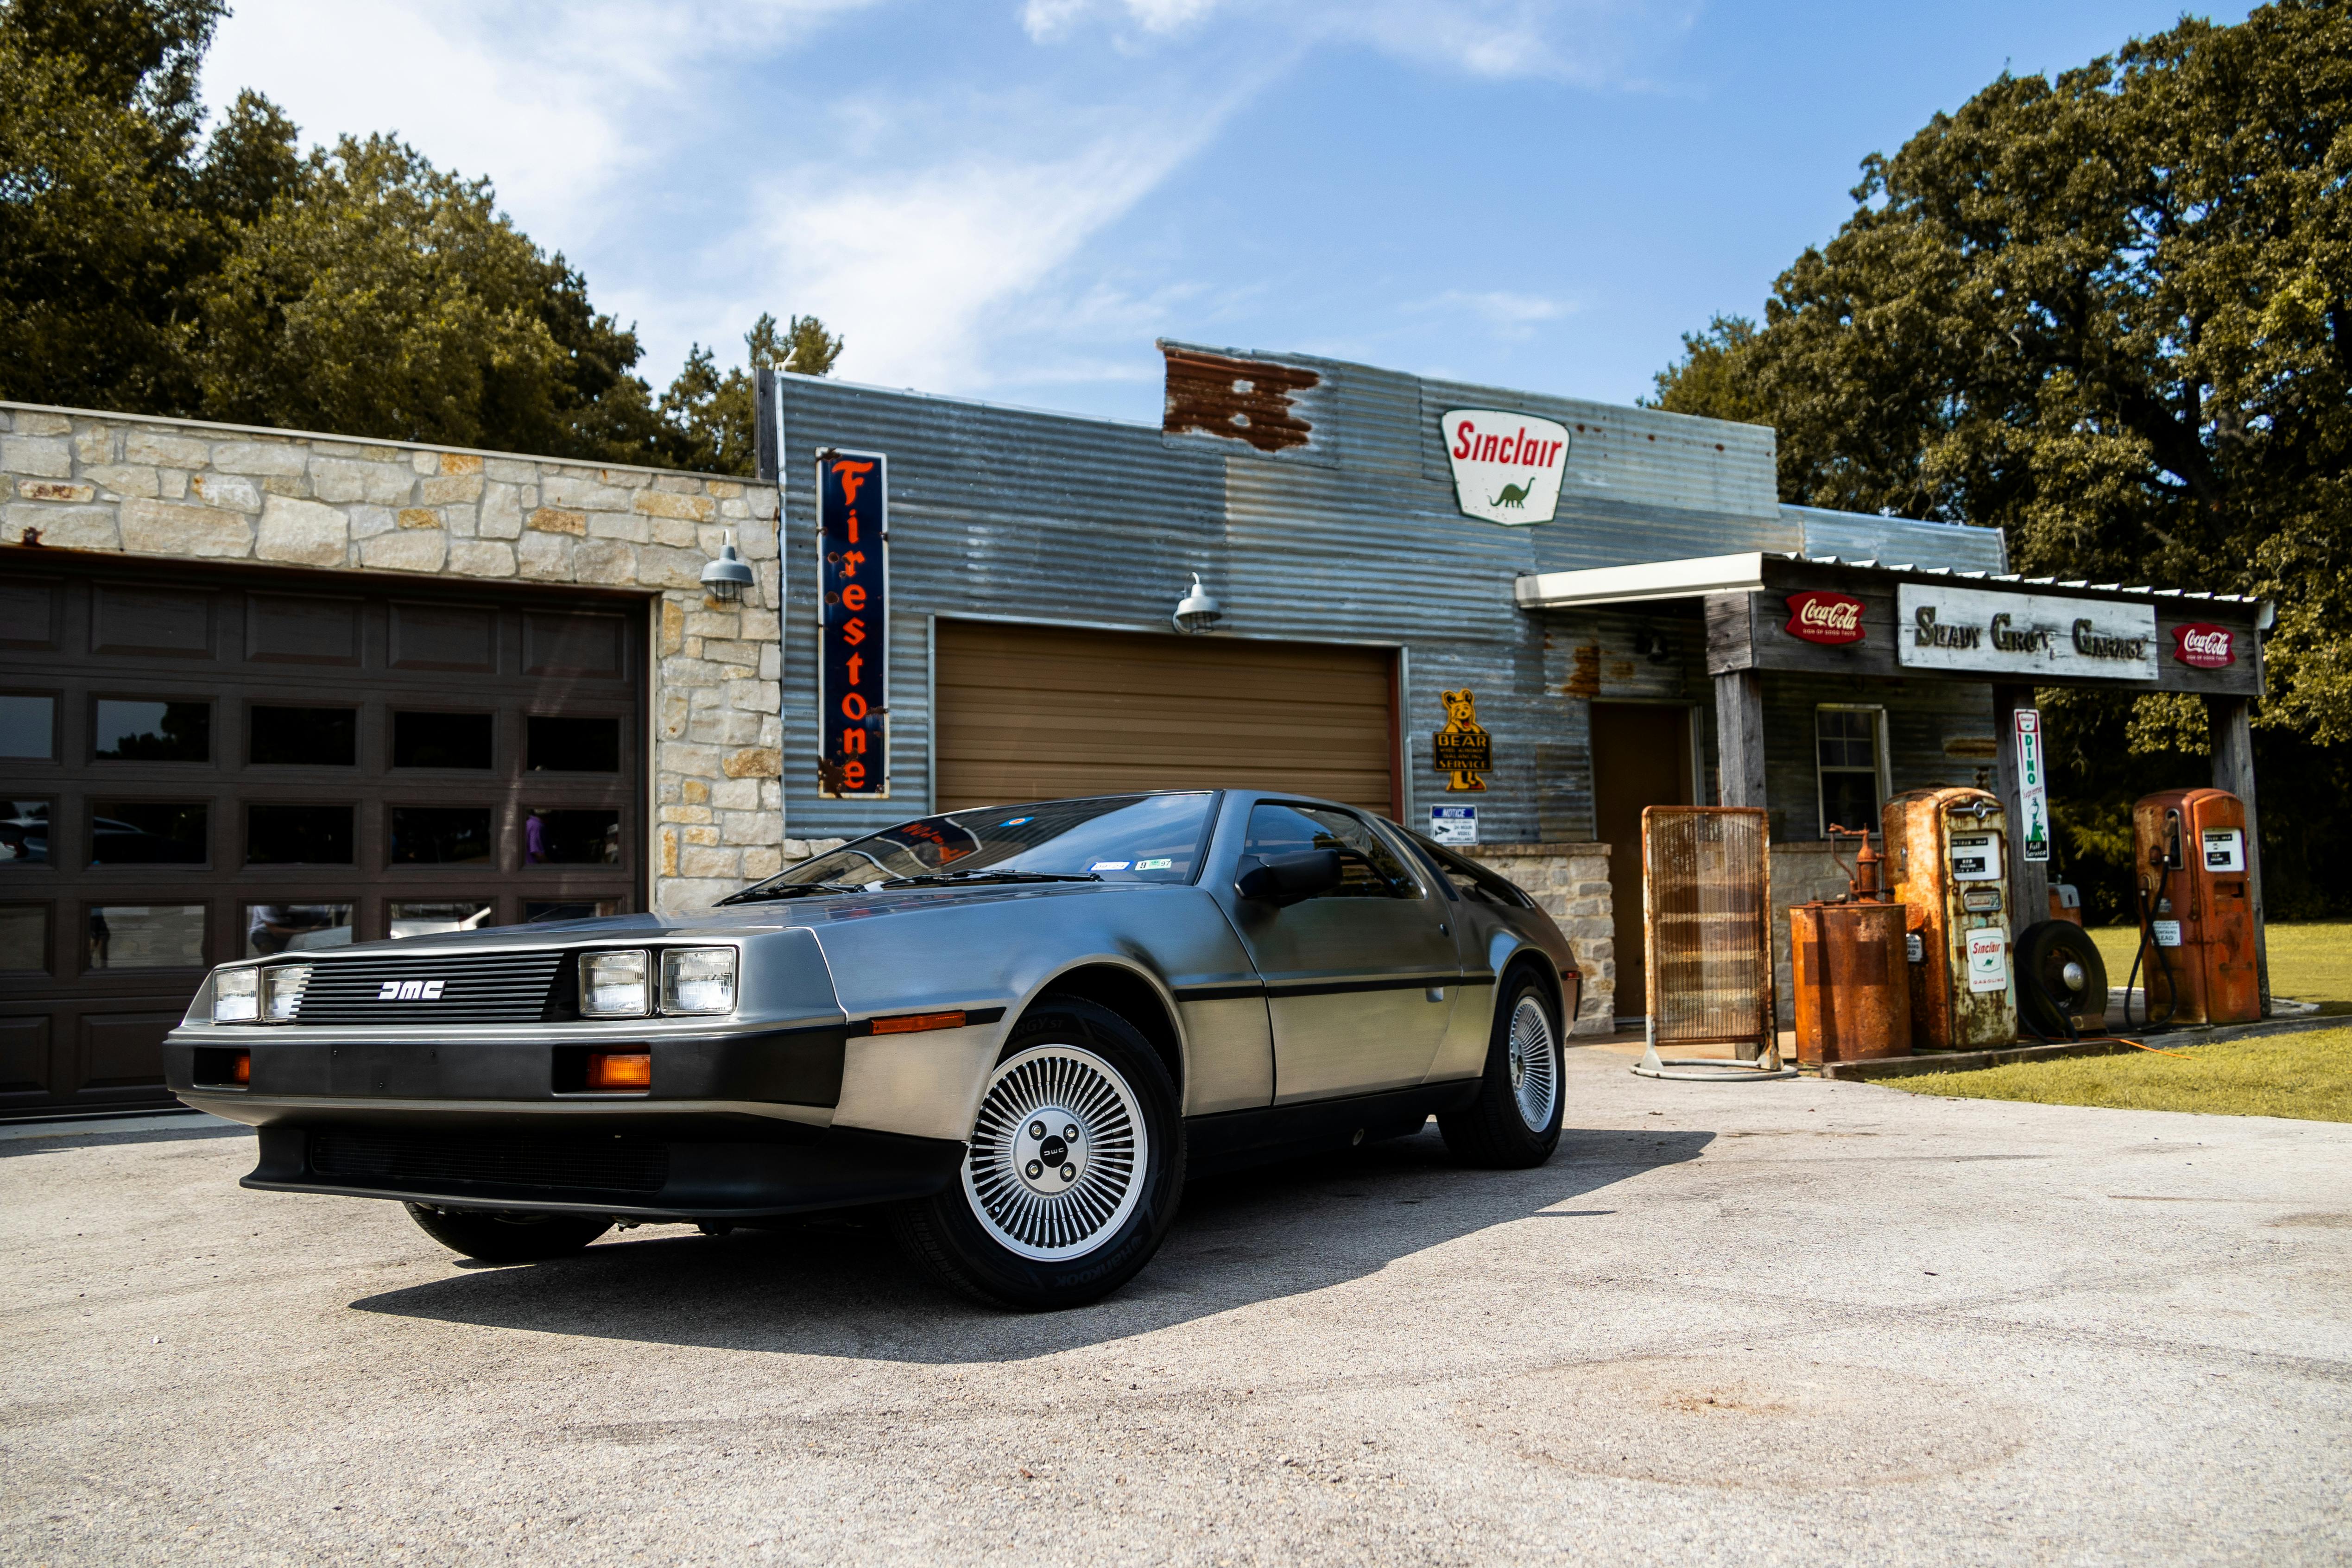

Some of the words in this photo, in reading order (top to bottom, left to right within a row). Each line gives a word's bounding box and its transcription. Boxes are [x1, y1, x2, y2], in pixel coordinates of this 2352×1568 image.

[1454, 420, 1563, 468] Sinclair
[1800, 598, 1860, 630] Coca-Cola
[832, 460, 874, 789] Firestone
[1438, 734, 1487, 747] BEAR
[1439, 760, 1486, 768] SERVICE
[2024, 734, 2036, 785] DINO
[2022, 785, 2043, 800] Supreme
[1442, 808, 1466, 818] NOTICE
[1973, 942, 2001, 954] Sinclair
[378, 980, 445, 999] DMC
